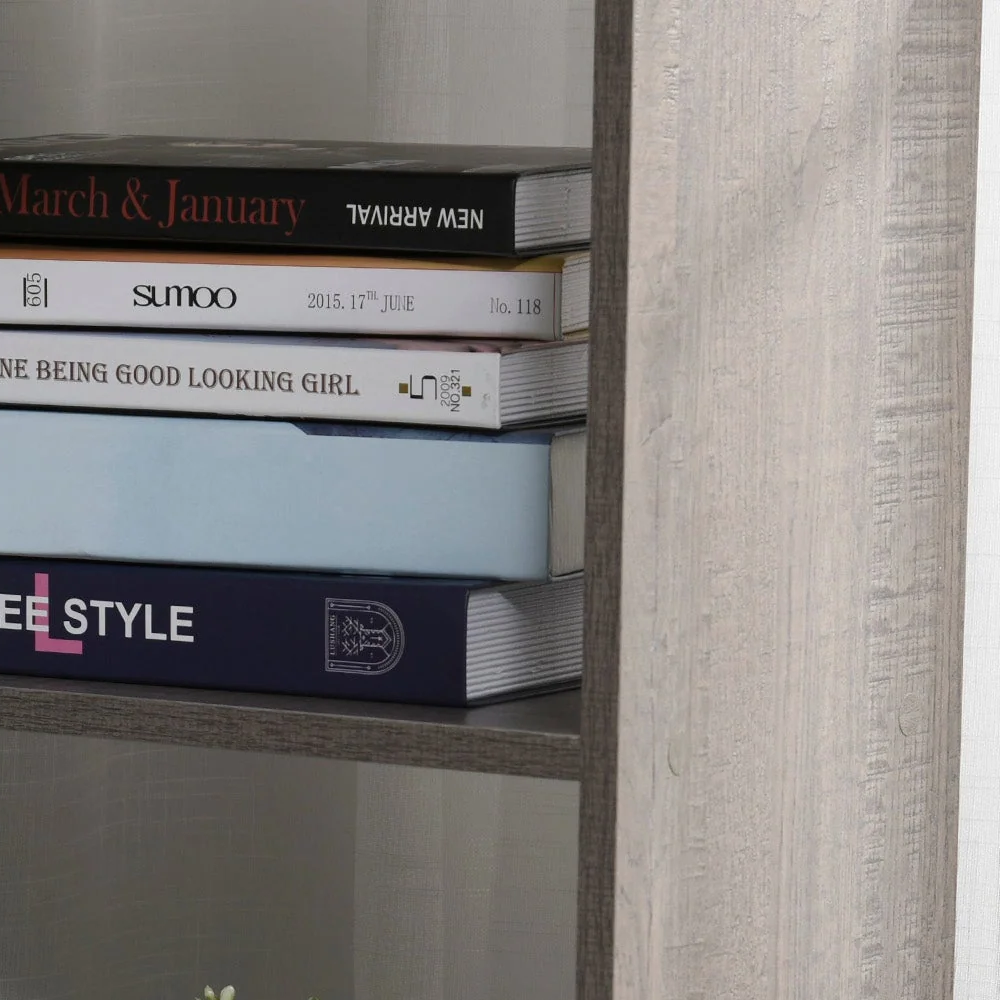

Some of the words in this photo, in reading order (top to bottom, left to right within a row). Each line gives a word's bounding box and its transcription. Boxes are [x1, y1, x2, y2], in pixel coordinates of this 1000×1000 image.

[121, 177, 151, 221] &
[157, 179, 306, 237] January
[346, 203, 432, 228] ARRIVAL
[437, 207, 483, 230] NEW
[26, 272, 42, 307] 605
[132, 284, 238, 310] sumoo
[380, 294, 415, 313] JUNE
[516, 298, 542, 315] 118
[36, 359, 108, 384] BEING
[115, 363, 181, 387] GOOD
[188, 367, 294, 393] LOOKING
[301, 372, 360, 397] GIRL
[63, 597, 195, 643] STYLE
